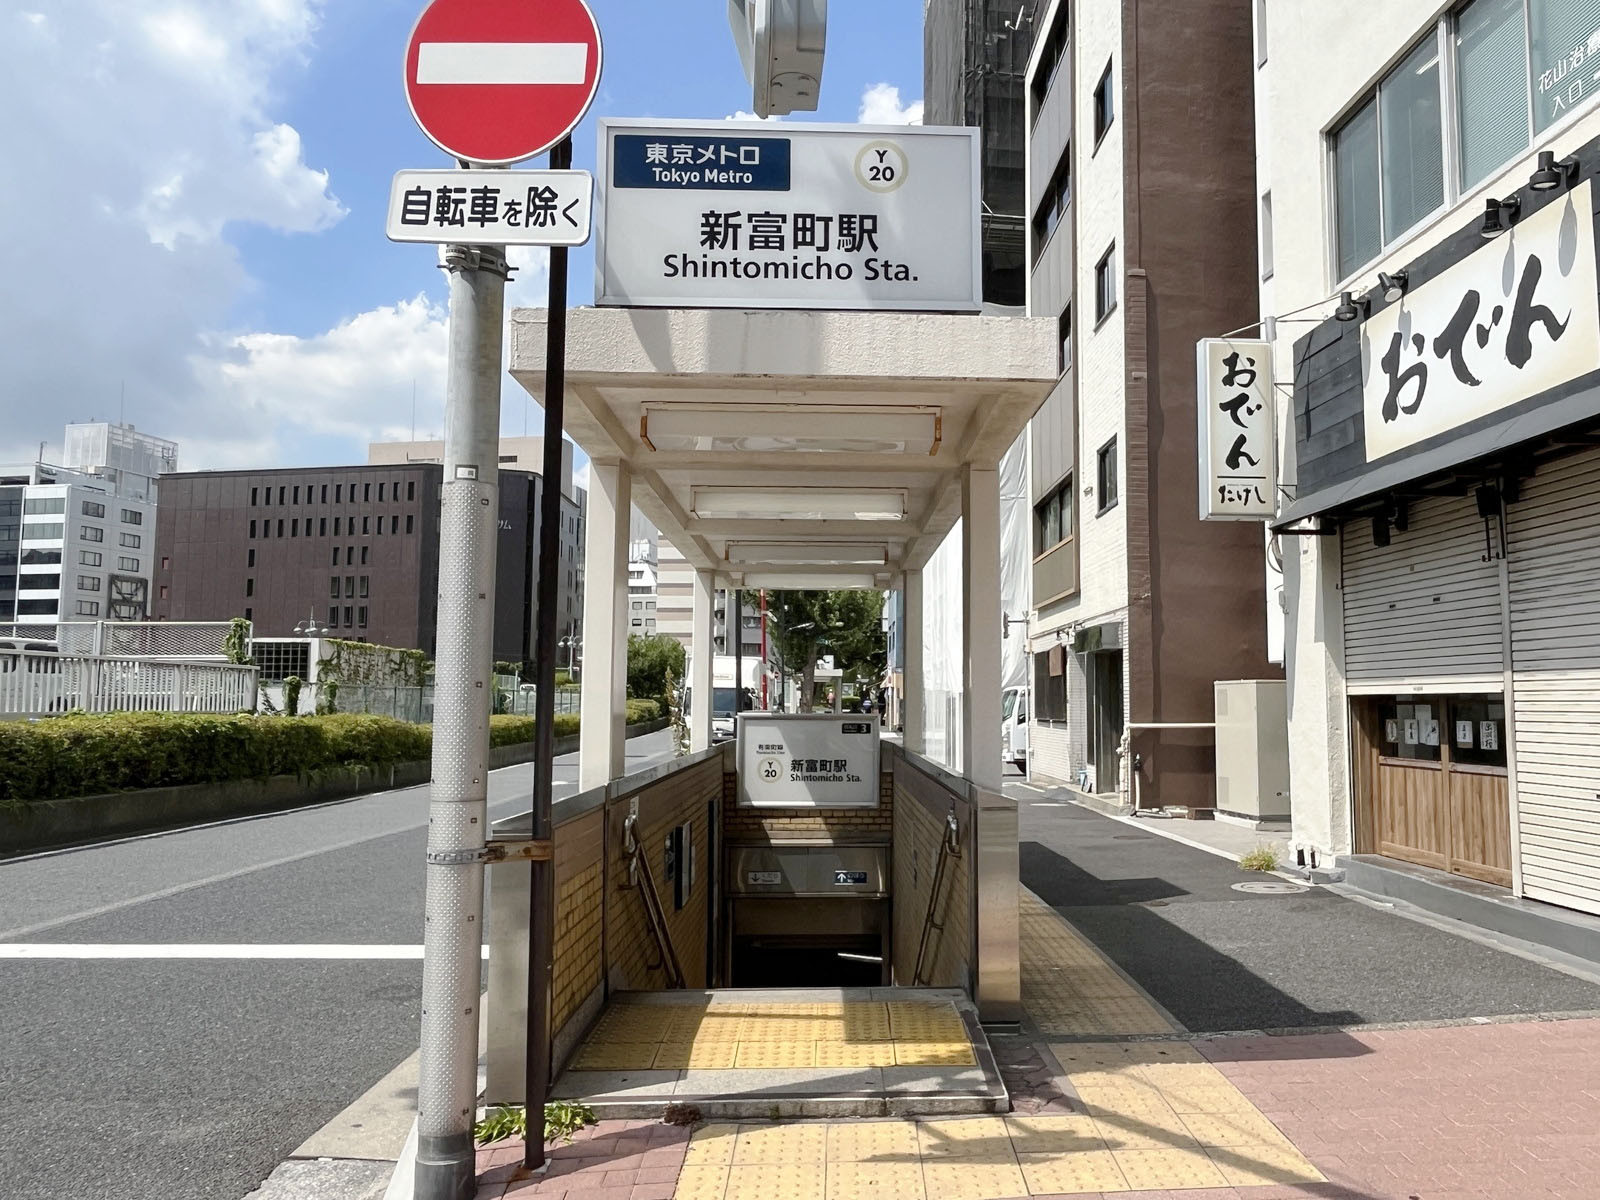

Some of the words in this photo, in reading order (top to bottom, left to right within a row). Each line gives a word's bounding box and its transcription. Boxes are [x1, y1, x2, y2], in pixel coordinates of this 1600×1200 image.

[645, 143, 760, 166] 東京メトロ
[875, 149, 886, 163] Y
[652, 168, 700, 185] Tokyo
[704, 168, 753, 184] Metro
[868, 166, 895, 182] 20
[400, 185, 579, 228] 自転車を除く
[699, 210, 879, 253] 新富町駅
[663, 253, 853, 281] Shintomicho
[864, 256, 919, 282] Sta.
[1381, 254, 1572, 424] おでん
[1218, 351, 1263, 471] おでん
[764, 769, 777, 778] 20
[767, 761, 774, 769] Y
[790, 759, 847, 773] 新富町駅
[790, 773, 844, 783] Shintomicho
[846, 774, 862, 783] Sta.
